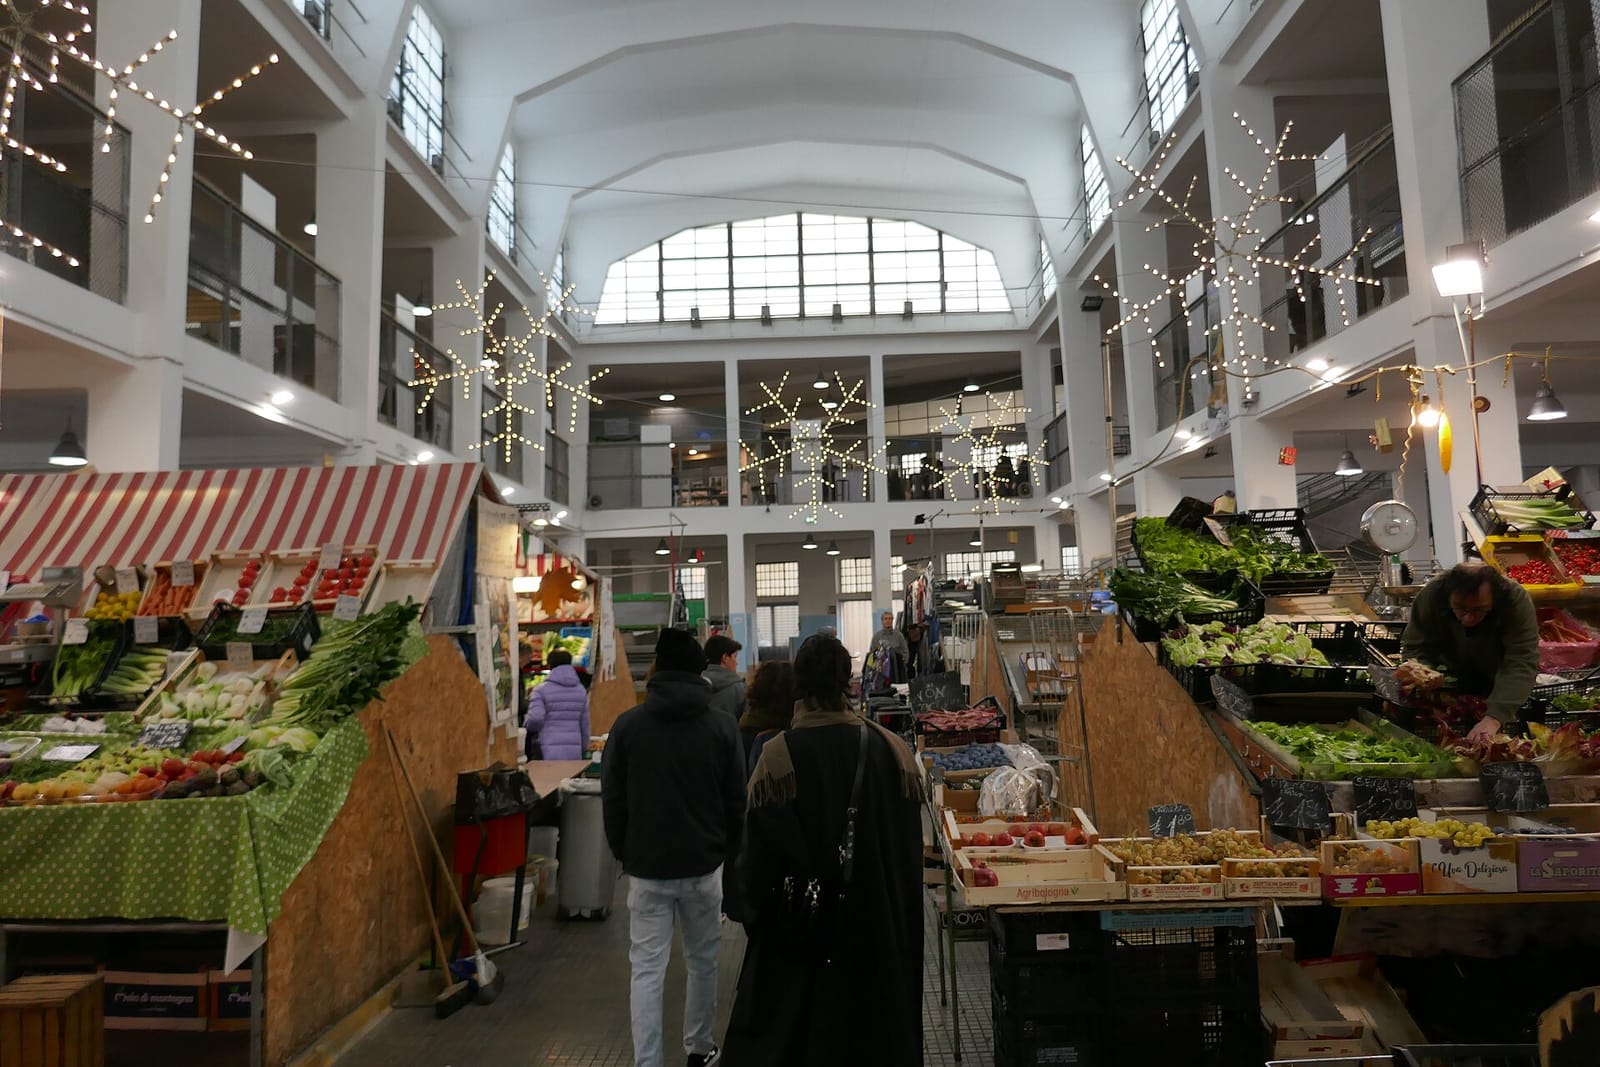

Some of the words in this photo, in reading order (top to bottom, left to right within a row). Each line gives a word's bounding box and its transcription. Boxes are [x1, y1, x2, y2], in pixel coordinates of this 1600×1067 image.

[1465, 861, 1508, 878] Deliziosa
[1016, 887, 1070, 899] Agribologna
[150, 993, 194, 1005] montagna
